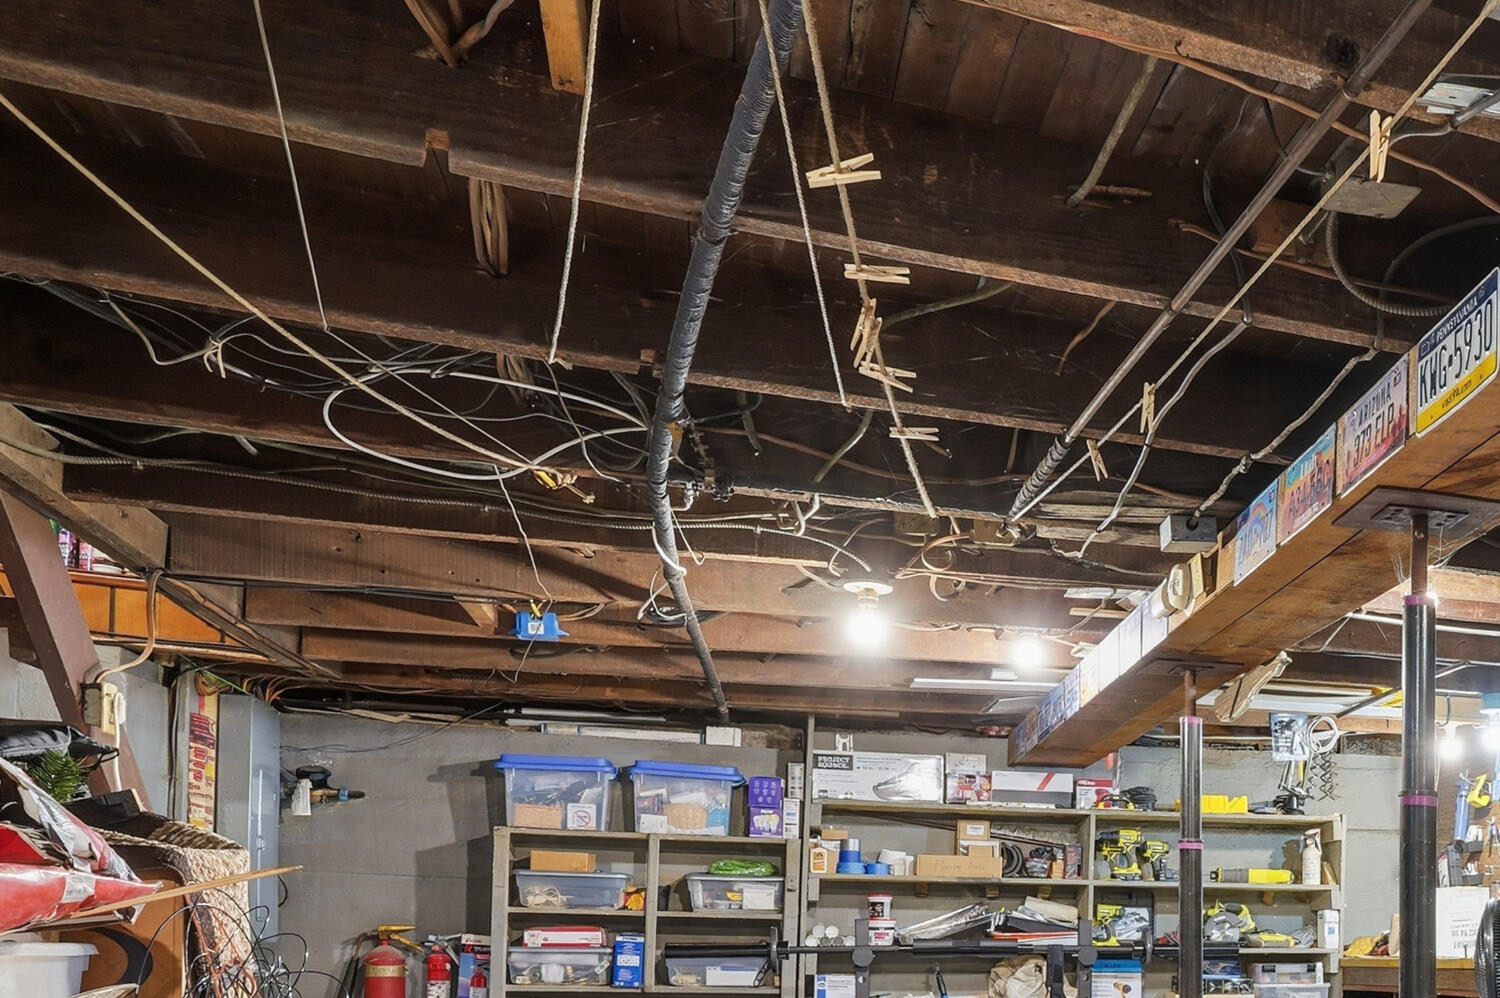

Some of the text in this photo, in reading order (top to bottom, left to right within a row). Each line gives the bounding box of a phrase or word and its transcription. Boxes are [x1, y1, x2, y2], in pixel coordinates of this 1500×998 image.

[1436, 297, 1478, 343] PENNSYLVANIA
[1358, 382, 1391, 428] ARIZONA
[817, 755, 851, 763] PROJECT
